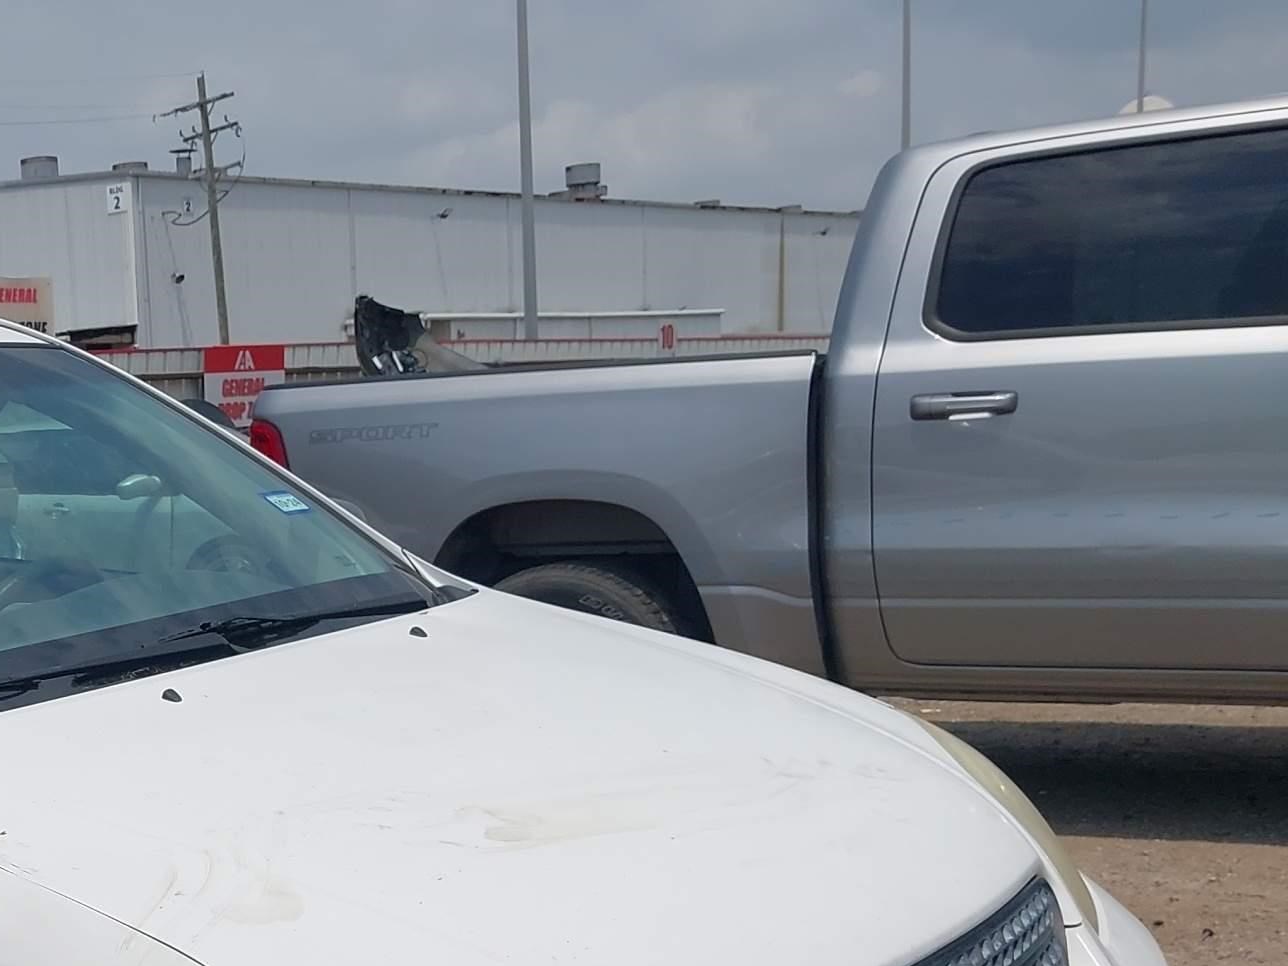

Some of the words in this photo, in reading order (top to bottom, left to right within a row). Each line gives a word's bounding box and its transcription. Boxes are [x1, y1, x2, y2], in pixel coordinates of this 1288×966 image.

[113, 196, 121, 210] 2
[661, 324, 674, 350] 10
[309, 422, 440, 446] SPORT
